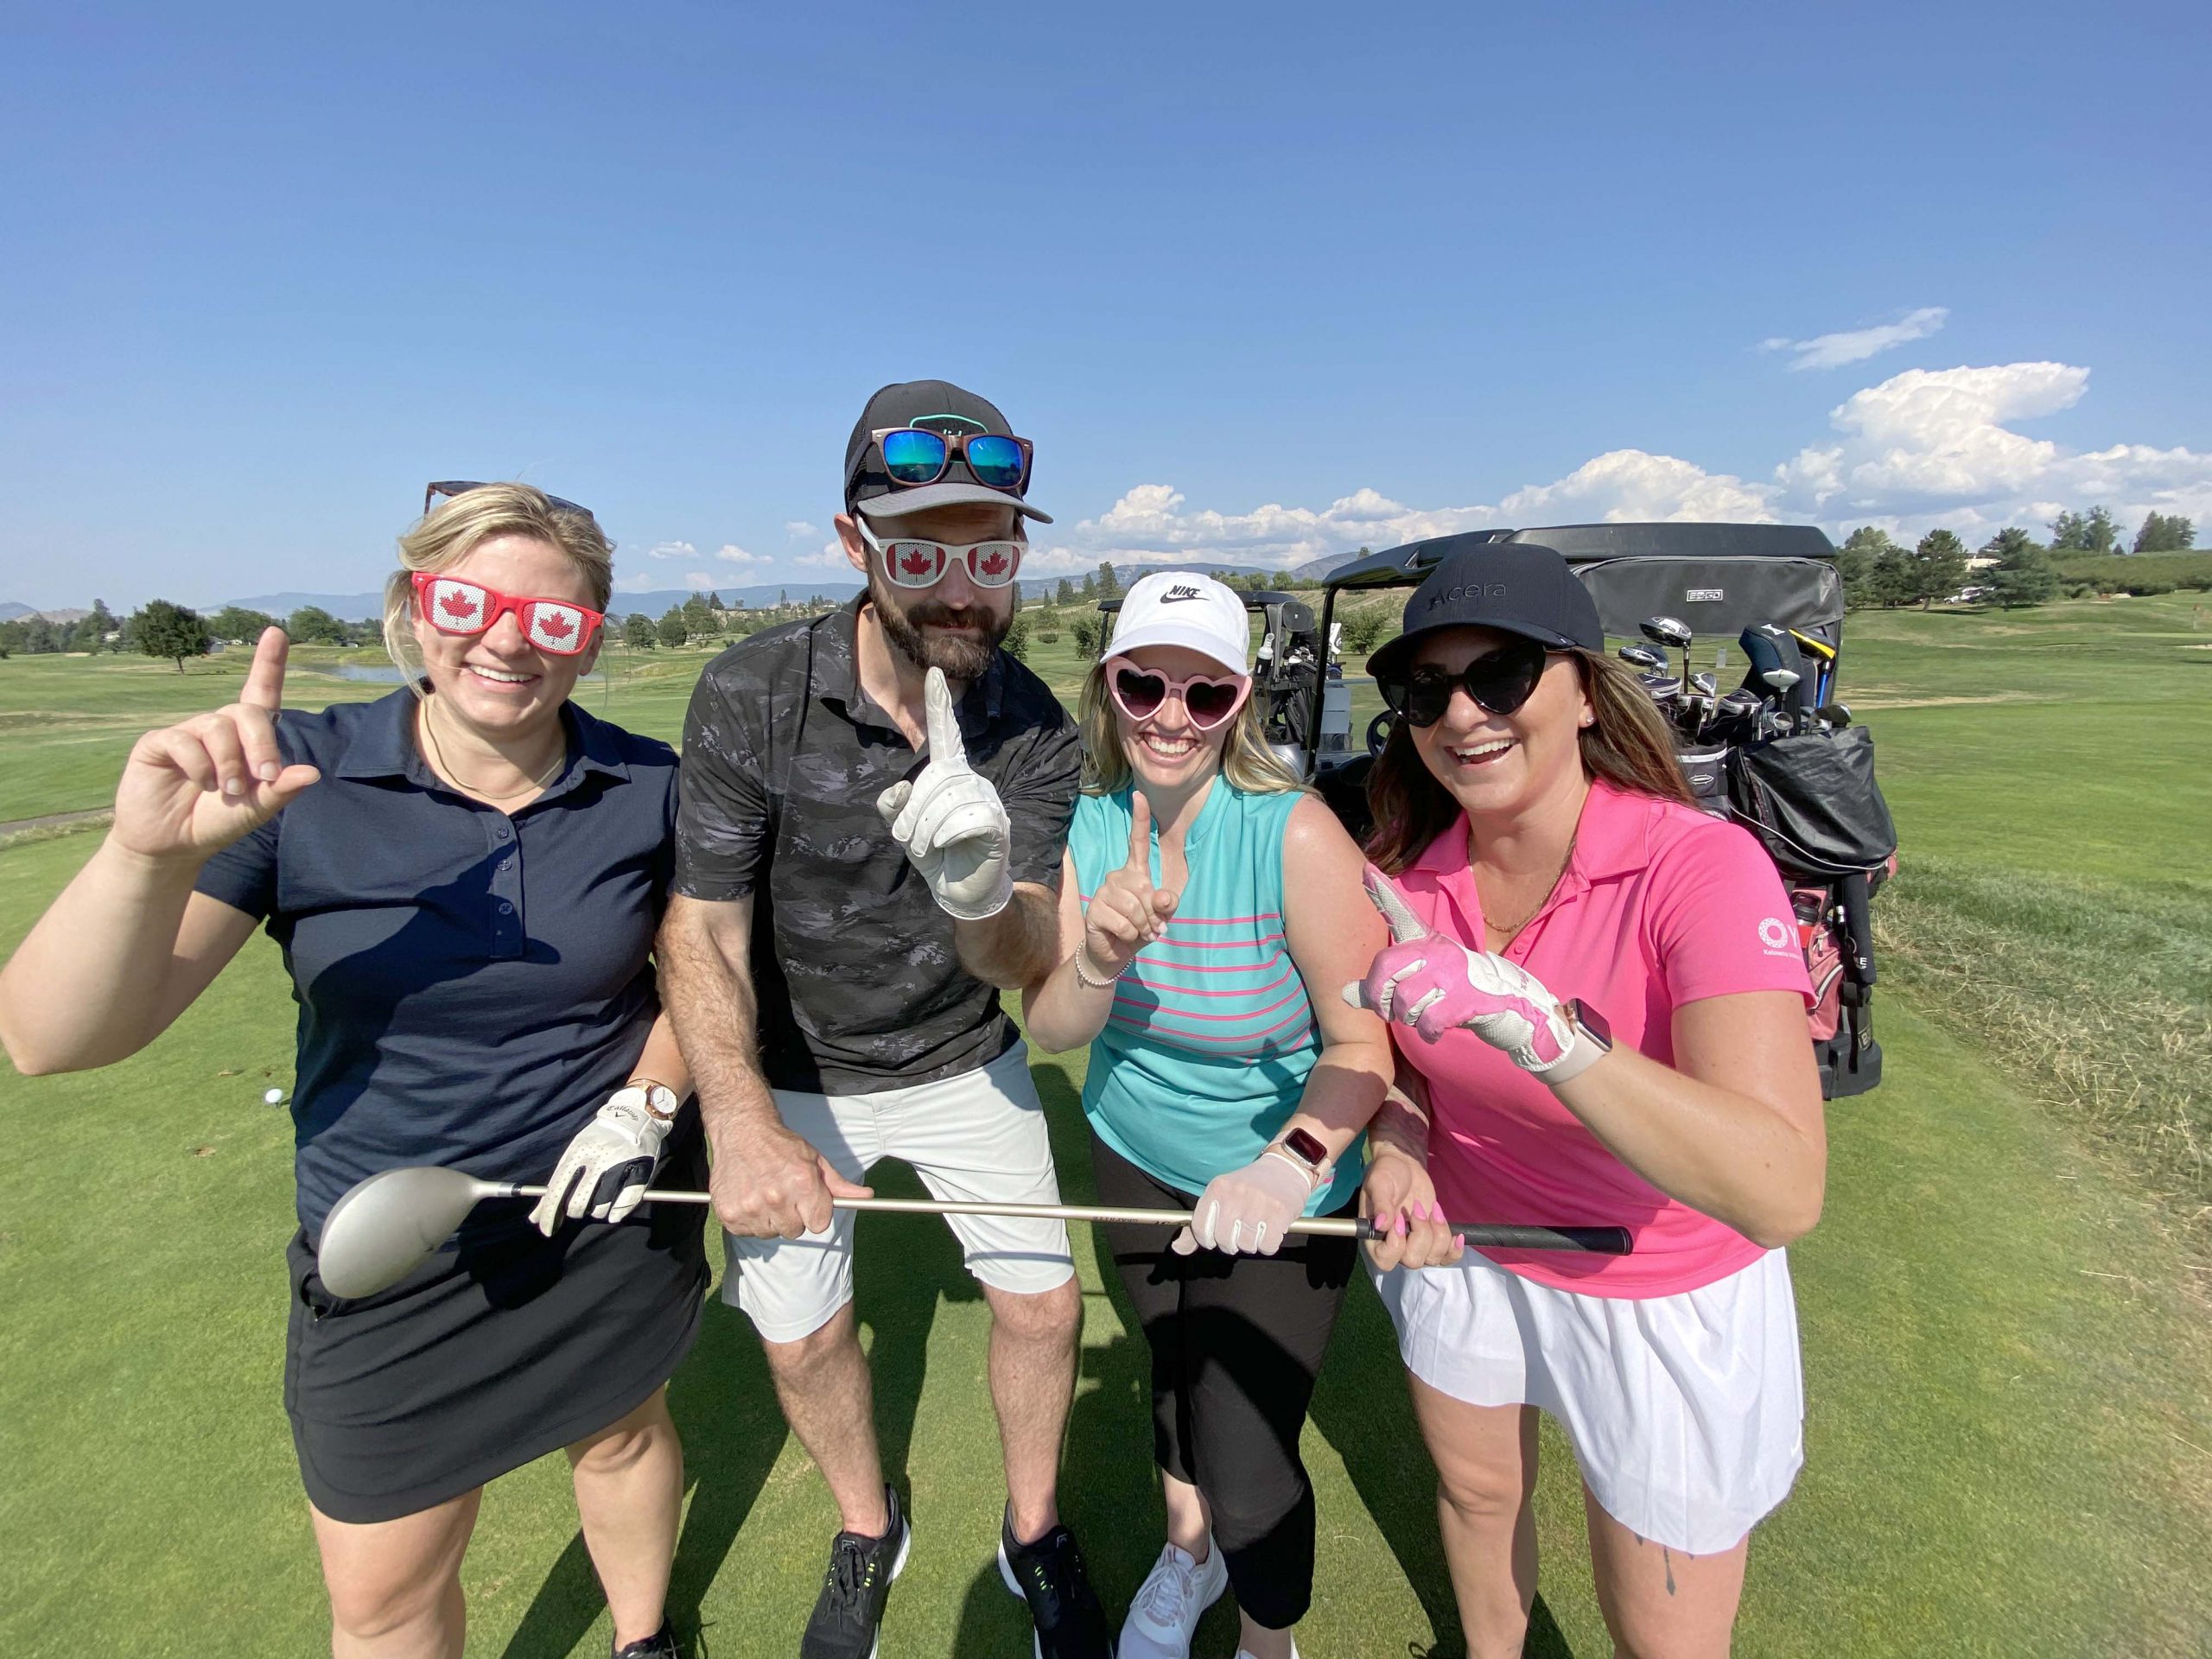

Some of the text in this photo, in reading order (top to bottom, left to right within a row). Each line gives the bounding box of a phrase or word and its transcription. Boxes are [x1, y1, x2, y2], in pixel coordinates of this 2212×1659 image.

[1169, 585, 1201, 598] NIKE
[1428, 583, 1506, 611] Acera
[607, 1105, 639, 1121] Callaway
